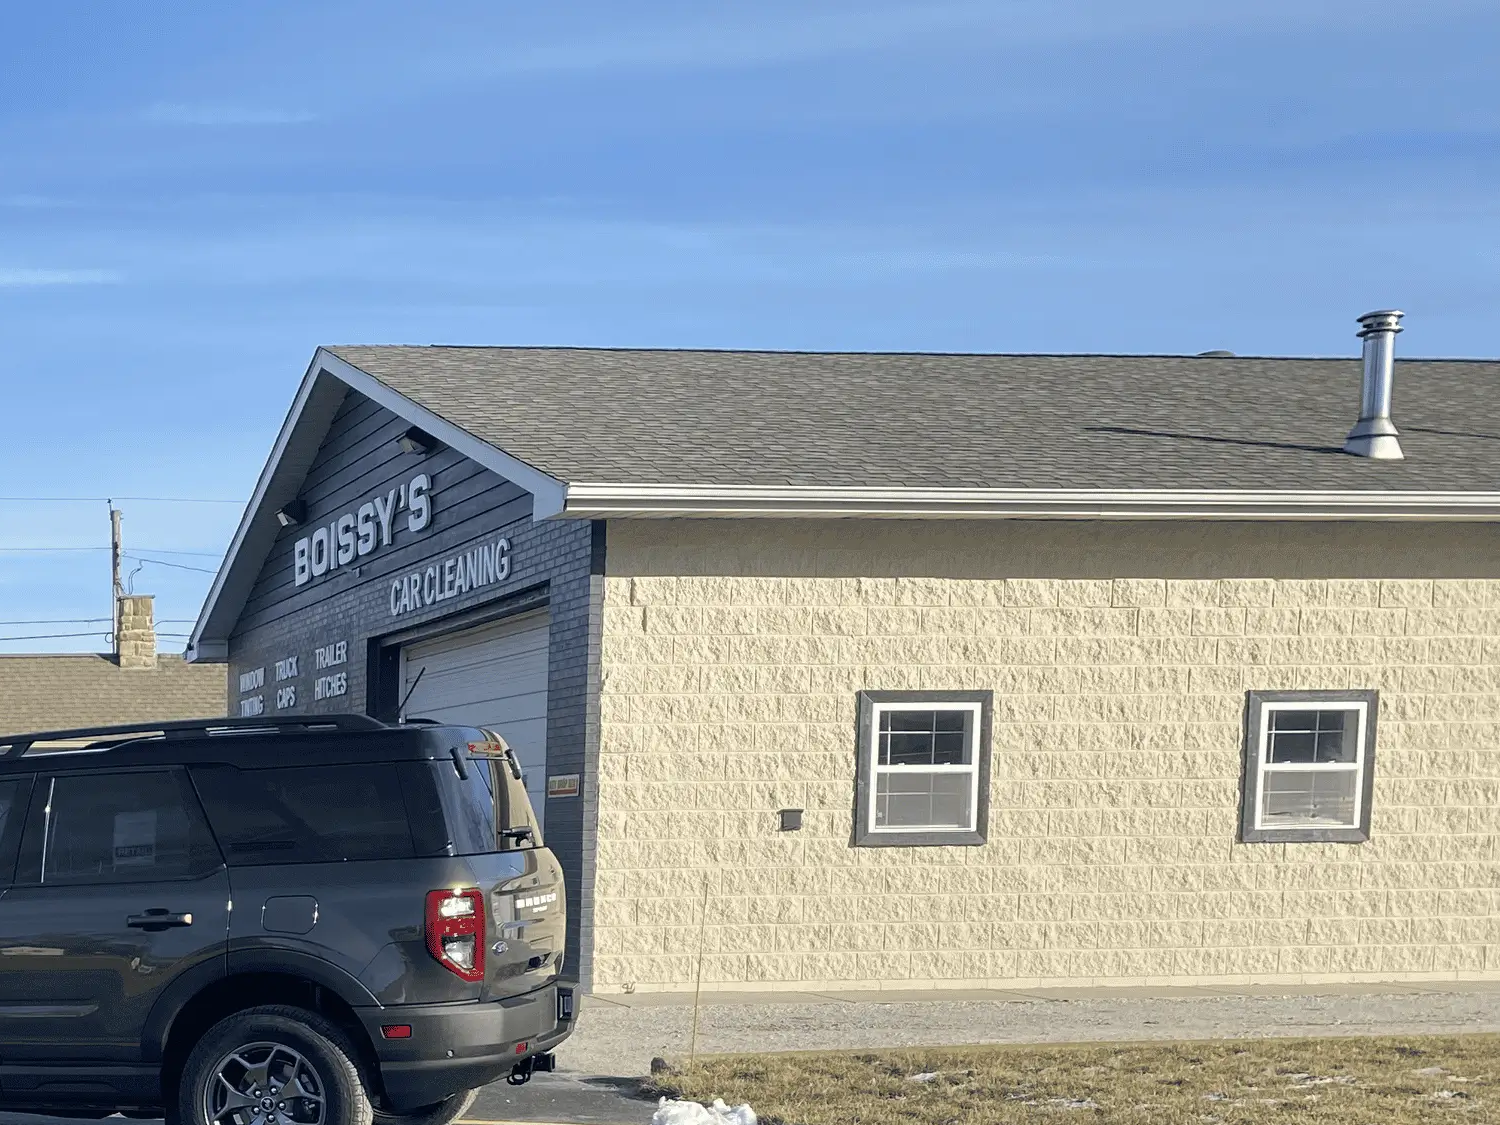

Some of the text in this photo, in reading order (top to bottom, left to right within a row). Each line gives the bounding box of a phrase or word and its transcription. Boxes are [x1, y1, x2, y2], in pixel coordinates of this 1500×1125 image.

[294, 473, 431, 587] BOISSY'S
[390, 538, 511, 616] CAR CLEANING
[315, 640, 348, 670] TRAILER
[240, 667, 265, 693] WINDOW
[275, 656, 299, 682] TRUCK
[276, 685, 296, 709] CAPS
[314, 672, 348, 701] HITCHES
[240, 695, 264, 718] TINTING
